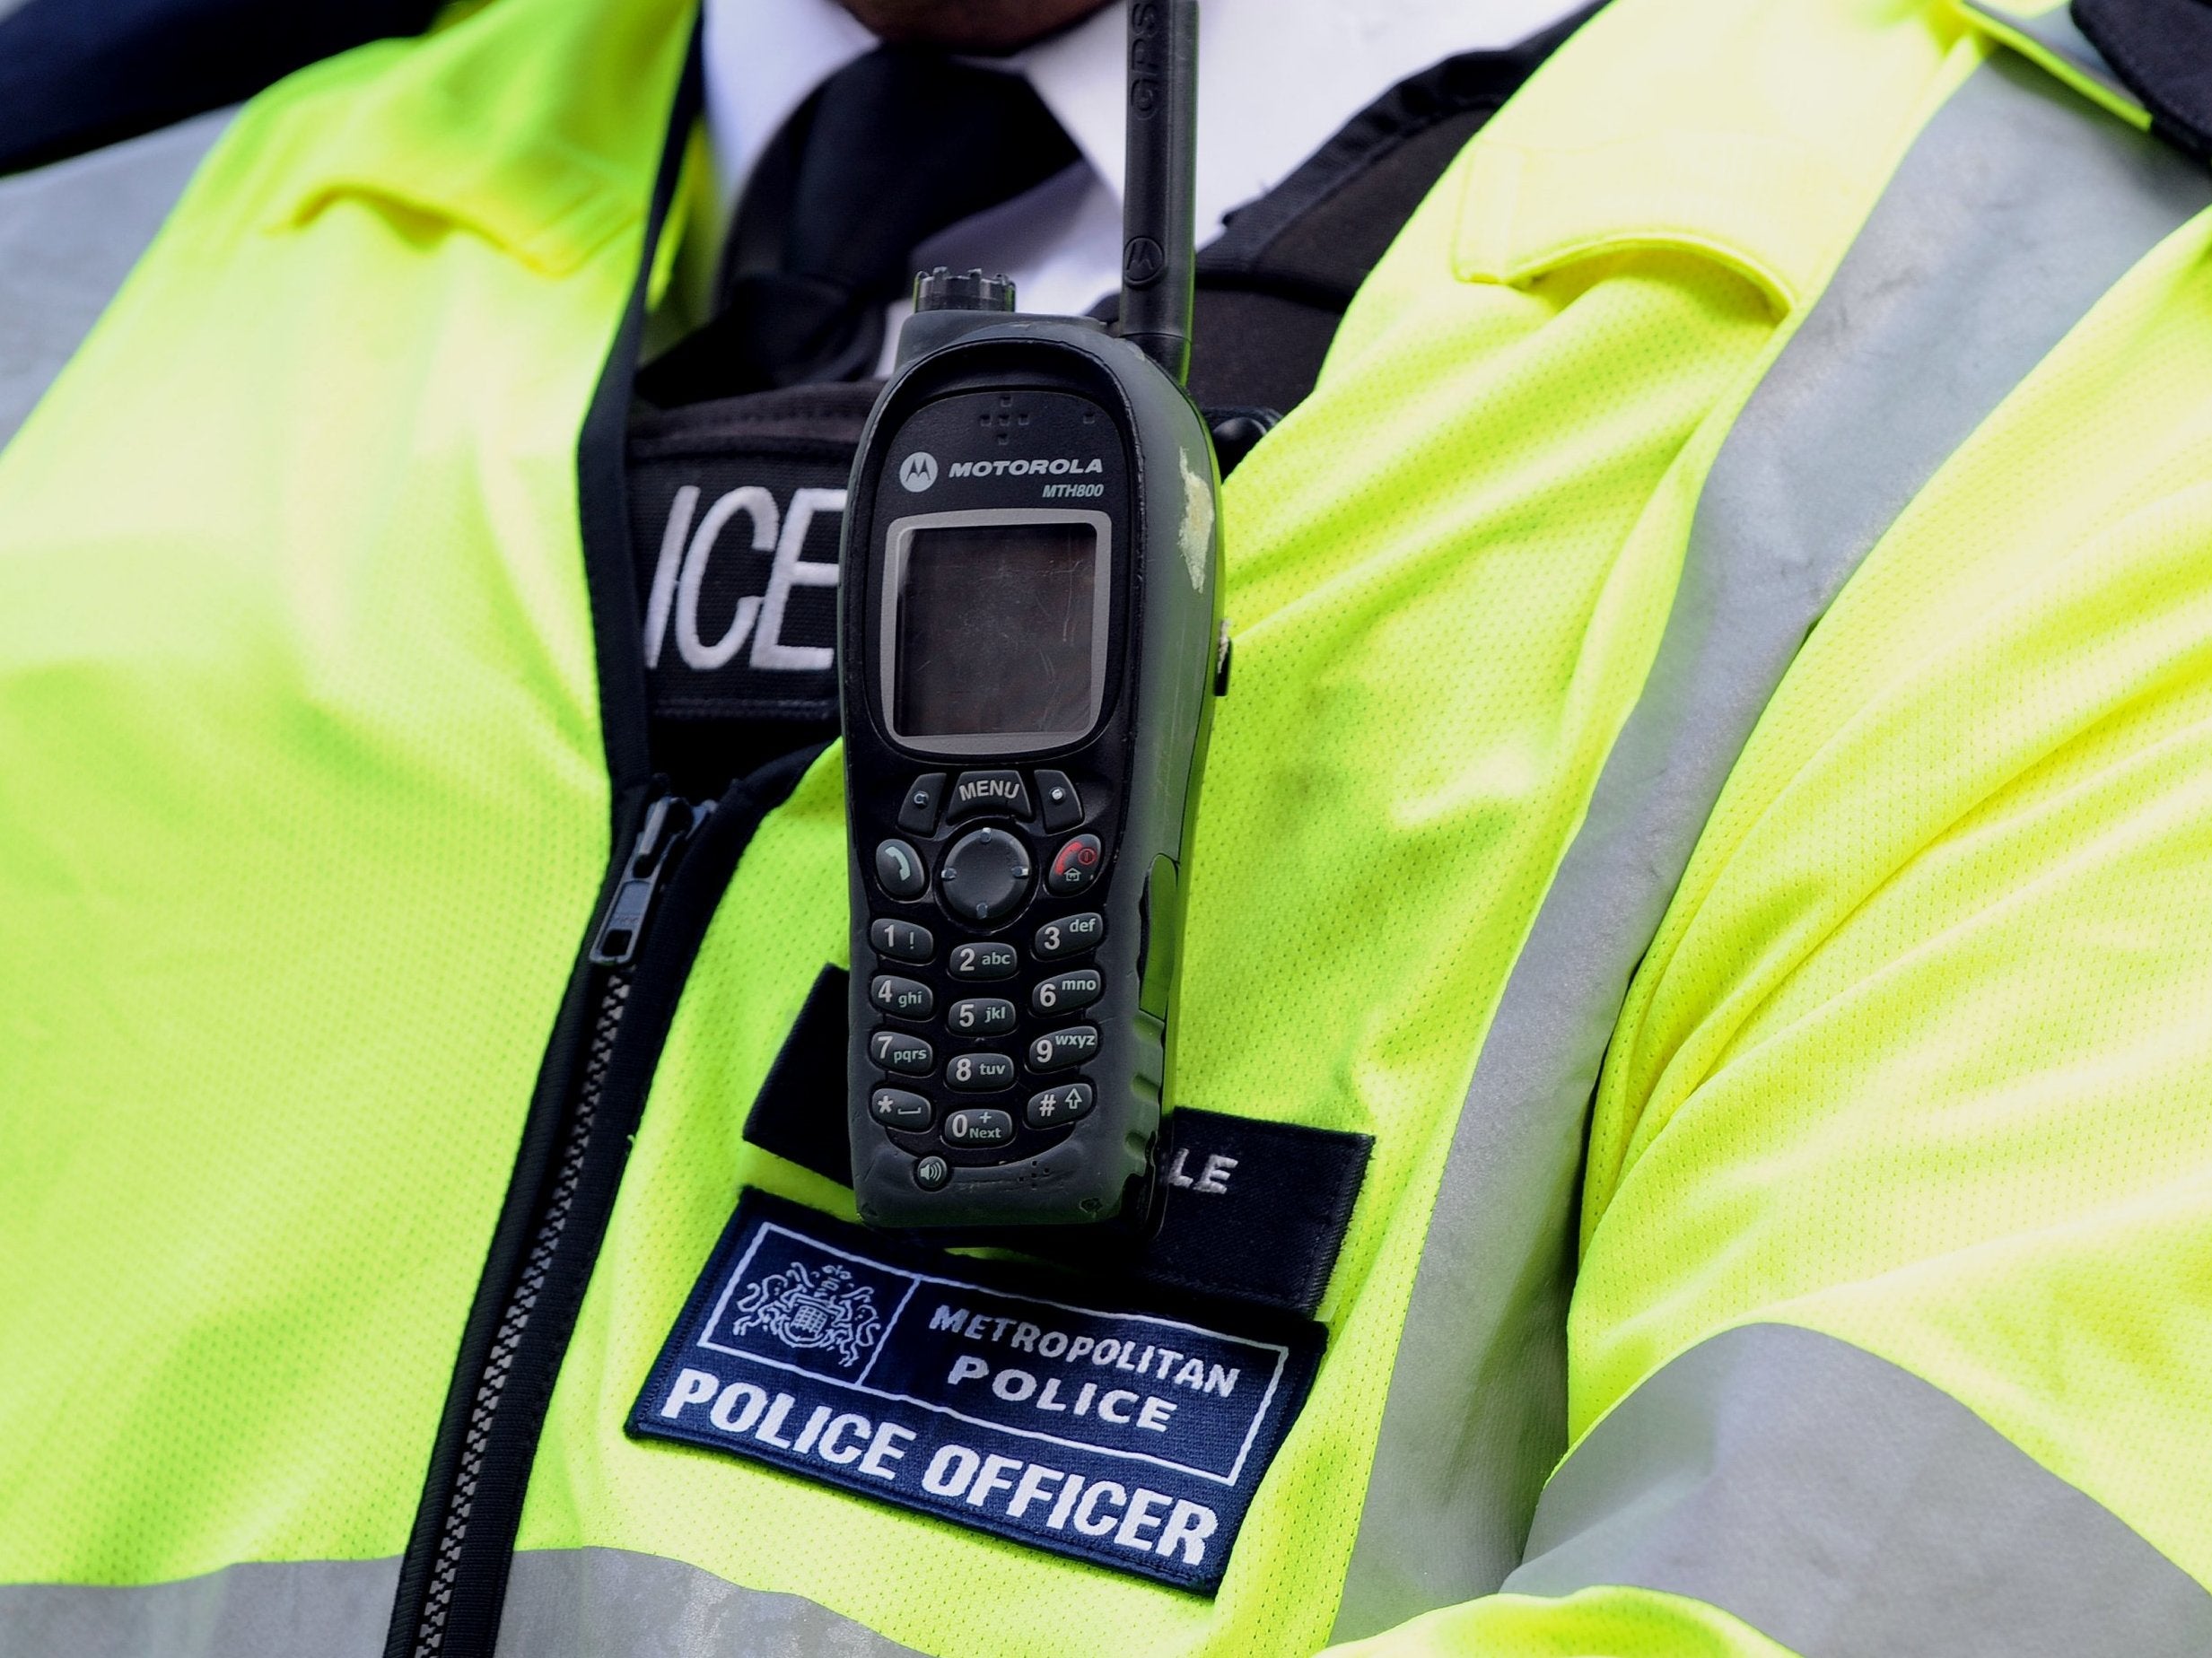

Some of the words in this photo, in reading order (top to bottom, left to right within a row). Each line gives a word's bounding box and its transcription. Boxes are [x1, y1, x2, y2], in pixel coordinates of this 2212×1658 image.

[1132, 2, 1159, 119] GPS
[949, 458, 1103, 478] MOTOROLA
[1042, 484, 1105, 498] MTH800
[645, 485, 848, 670] ICE
[958, 780, 1019, 801] MENU
[884, 924, 895, 947] 1
[1044, 926, 1061, 950] 3
[1069, 918, 1096, 934] def
[959, 947, 975, 972] 2
[982, 952, 1010, 965] abc
[878, 980, 892, 1003] 4
[898, 990, 922, 1006] ghi
[1039, 983, 1056, 1008] 6
[1062, 978, 1097, 991] mno
[959, 1003, 975, 1027] 5
[984, 1007, 1006, 1023] jkl
[878, 1036, 892, 1060] 7
[894, 1048, 927, 1062] pqrs
[1036, 1039, 1054, 1063] 9
[1055, 1034, 1096, 1048] wxyz
[956, 1057, 972, 1082] 8
[980, 1062, 1005, 1076] tuv
[1039, 1095, 1056, 1116] #
[952, 1114, 967, 1138] 0
[970, 1128, 1001, 1139] Next
[1168, 1148, 1239, 1195] LE
[930, 1305, 1241, 1400] METROPOLITAN
[948, 1356, 1178, 1433] POLICE
[662, 1367, 916, 1479] POLICE
[921, 1443, 1220, 1566] OFFICER
